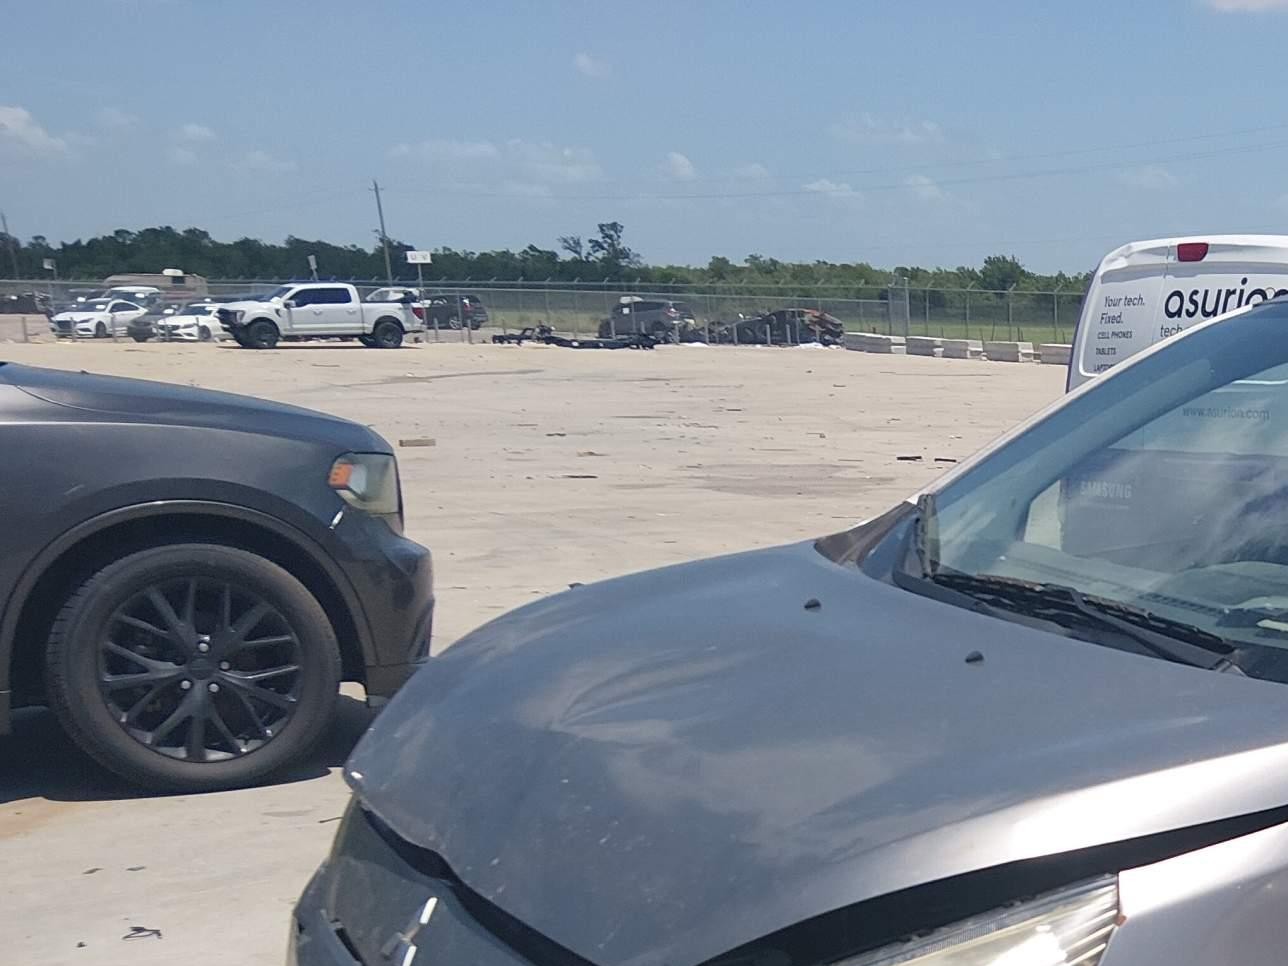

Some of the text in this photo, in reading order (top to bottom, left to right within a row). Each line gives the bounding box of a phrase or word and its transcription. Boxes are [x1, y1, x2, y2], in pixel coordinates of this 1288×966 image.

[1104, 293, 1145, 308] Your tech.
[1100, 312, 1124, 325] Fixed.
[1111, 330, 1133, 339] PHONES
[1095, 347, 1117, 356] TABLETS
